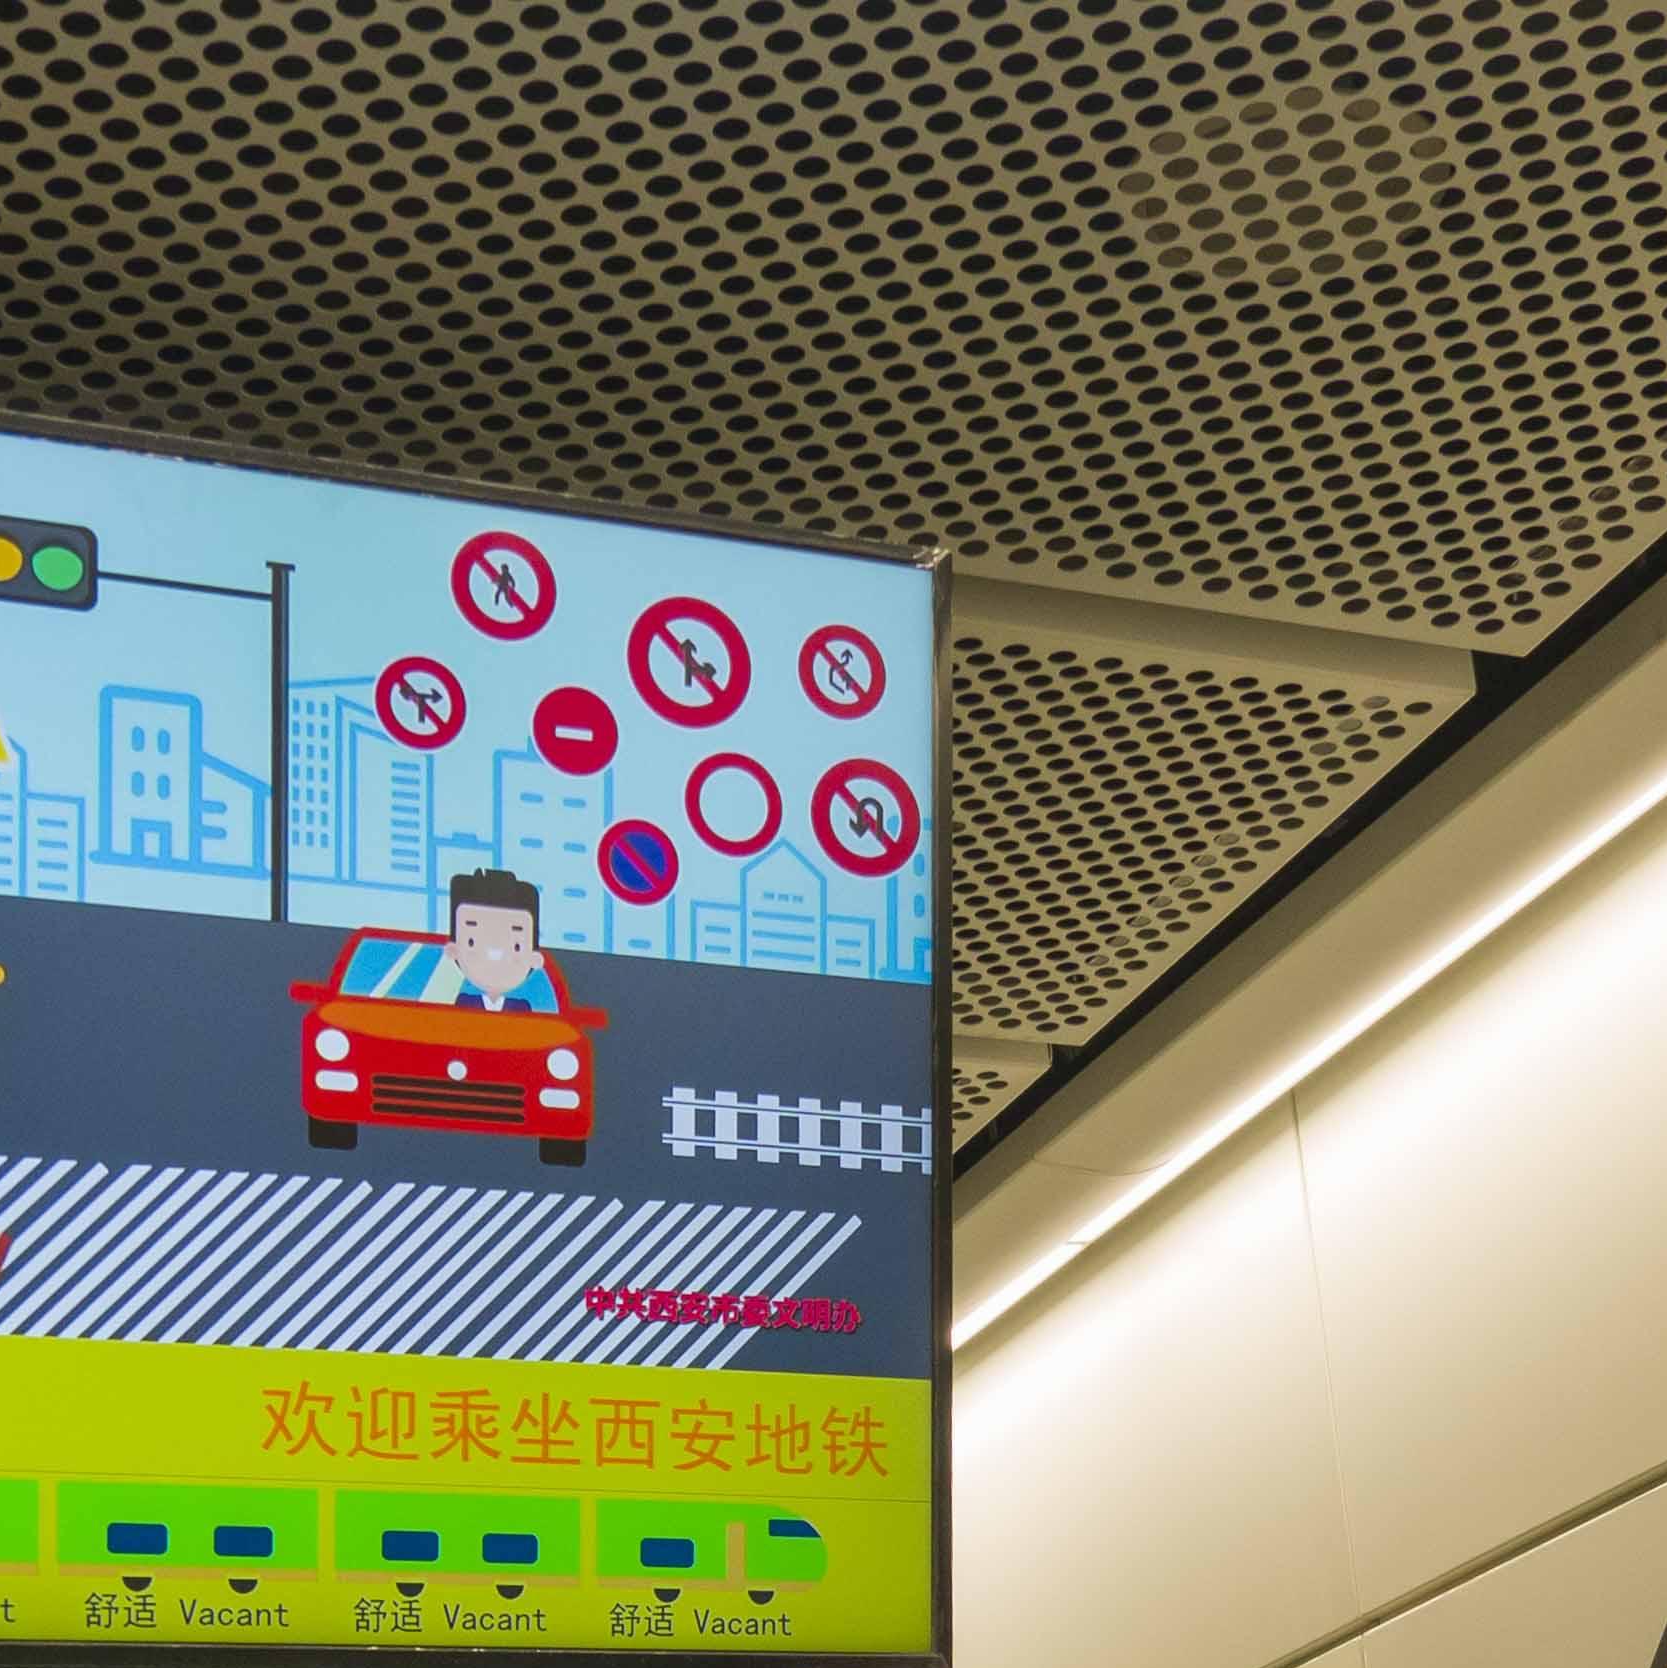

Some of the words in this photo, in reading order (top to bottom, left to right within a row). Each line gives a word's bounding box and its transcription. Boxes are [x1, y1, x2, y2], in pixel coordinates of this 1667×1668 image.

[585, 1286, 860, 1332] 中共西安市委文明办
[261, 1380, 889, 1478] 欢迎乘坐西安地铁
[85, 1591, 157, 1629] 舒适
[179, 1599, 289, 1628] Vacant
[354, 1599, 423, 1634] 舒适
[444, 1603, 547, 1633] Vacant
[610, 1603, 674, 1639] 舒适
[694, 1609, 792, 1637] Vacant
